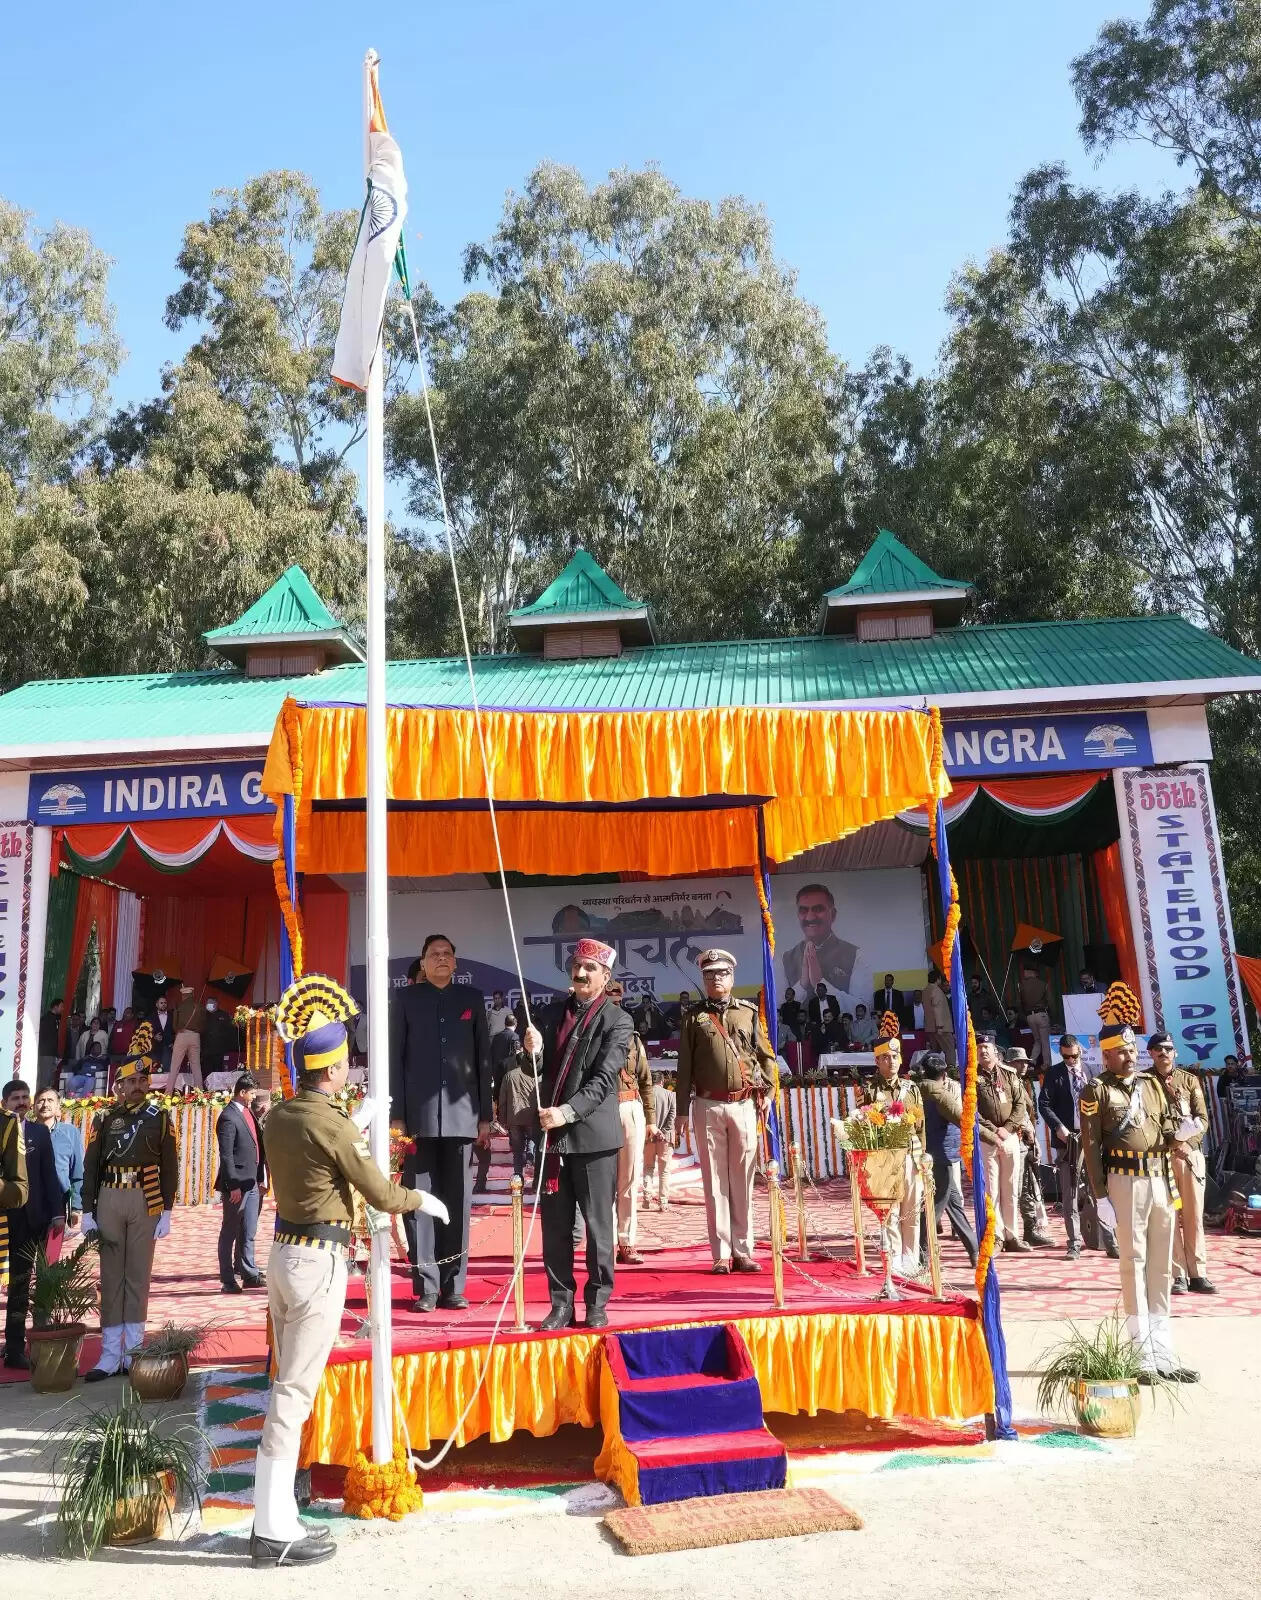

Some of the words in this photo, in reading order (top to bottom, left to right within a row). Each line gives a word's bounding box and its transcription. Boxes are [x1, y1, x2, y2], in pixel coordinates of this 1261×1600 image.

[103, 773, 228, 813] INDIRA
[240, 771, 273, 805] G
[1139, 781, 1197, 810] 55th
[582, 898, 611, 906] व्यवस्था
[612, 893, 642, 905] परिवर्तन
[652, 891, 691, 903] आत्मनिर्भर
[1156, 814, 1211, 981] STATEHOOD
[1178, 1003, 1220, 1061] DAY
